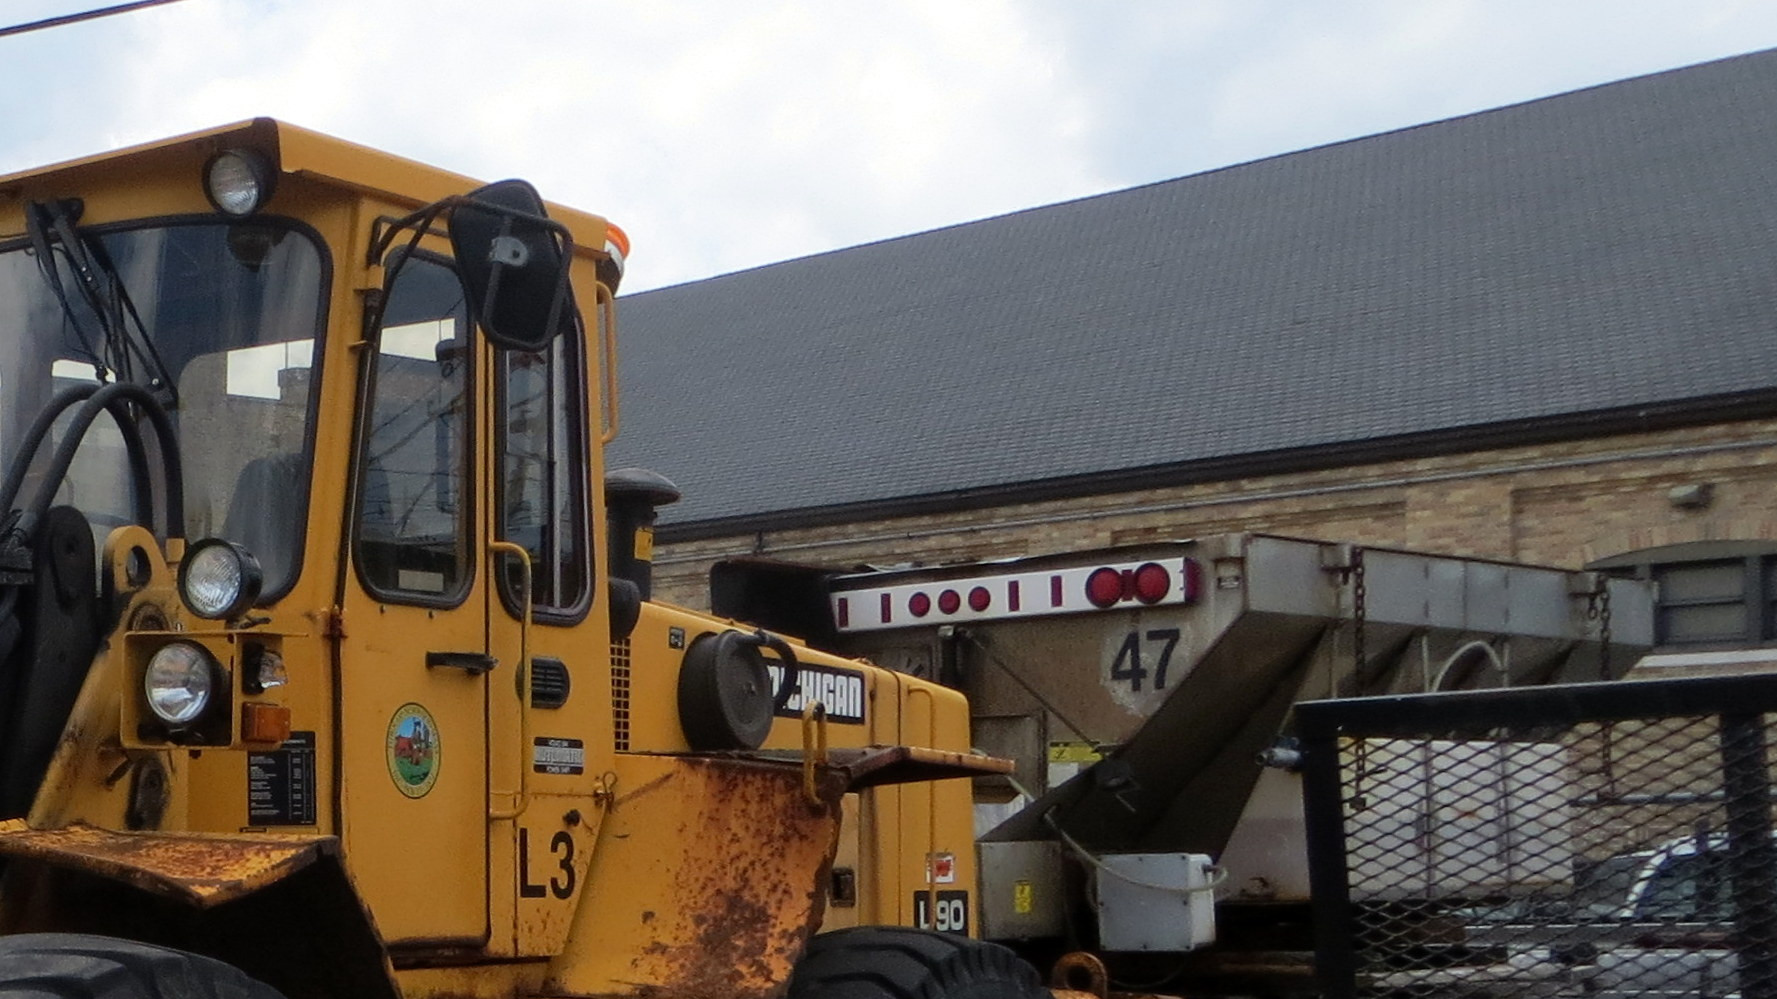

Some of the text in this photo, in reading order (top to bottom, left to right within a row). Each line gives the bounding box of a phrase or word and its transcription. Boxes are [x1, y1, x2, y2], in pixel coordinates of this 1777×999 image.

[767, 665, 862, 718] CHIGAN
[1111, 628, 1180, 692] 47
[520, 828, 575, 900] L3
